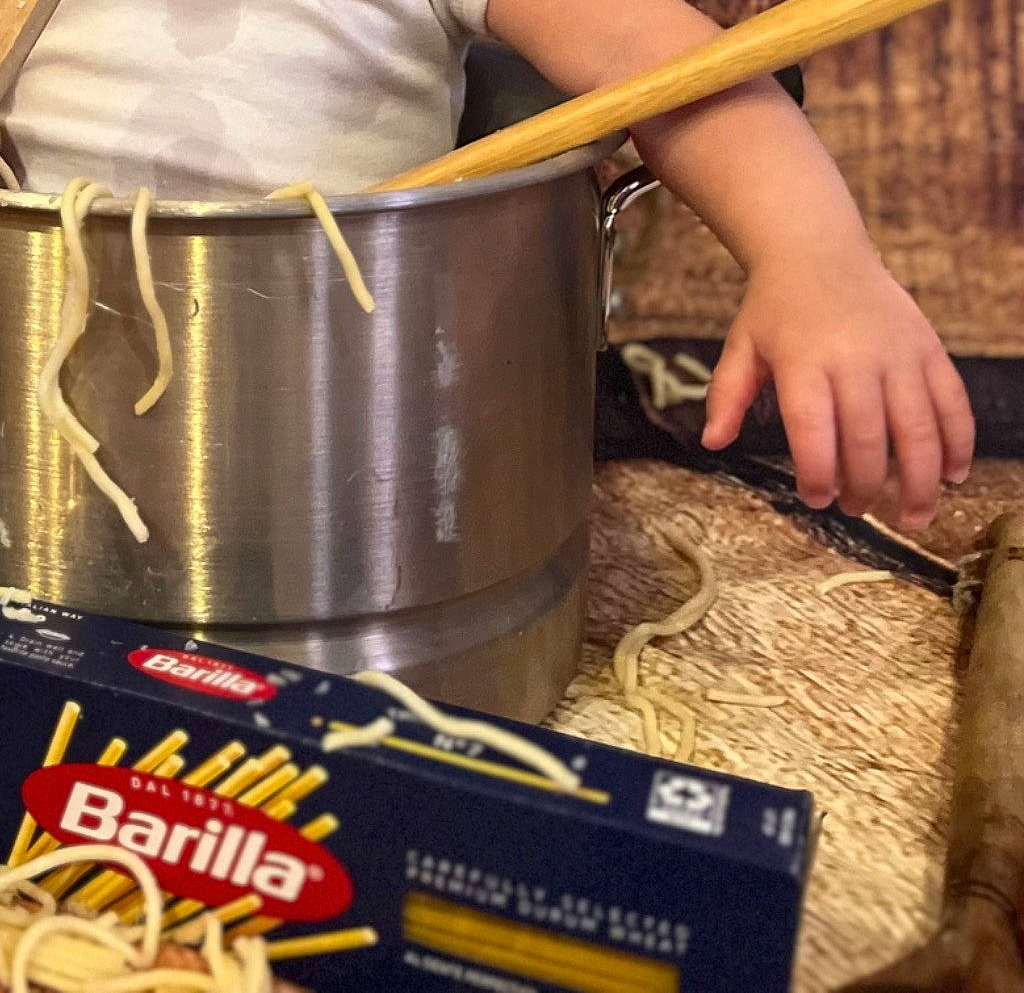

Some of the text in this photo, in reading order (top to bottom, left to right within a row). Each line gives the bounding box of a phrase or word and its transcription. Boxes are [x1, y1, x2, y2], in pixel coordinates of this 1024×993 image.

[142, 653, 257, 695] Barilla
[130, 775, 172, 798] DAL
[59, 780, 308, 903] Barilla
